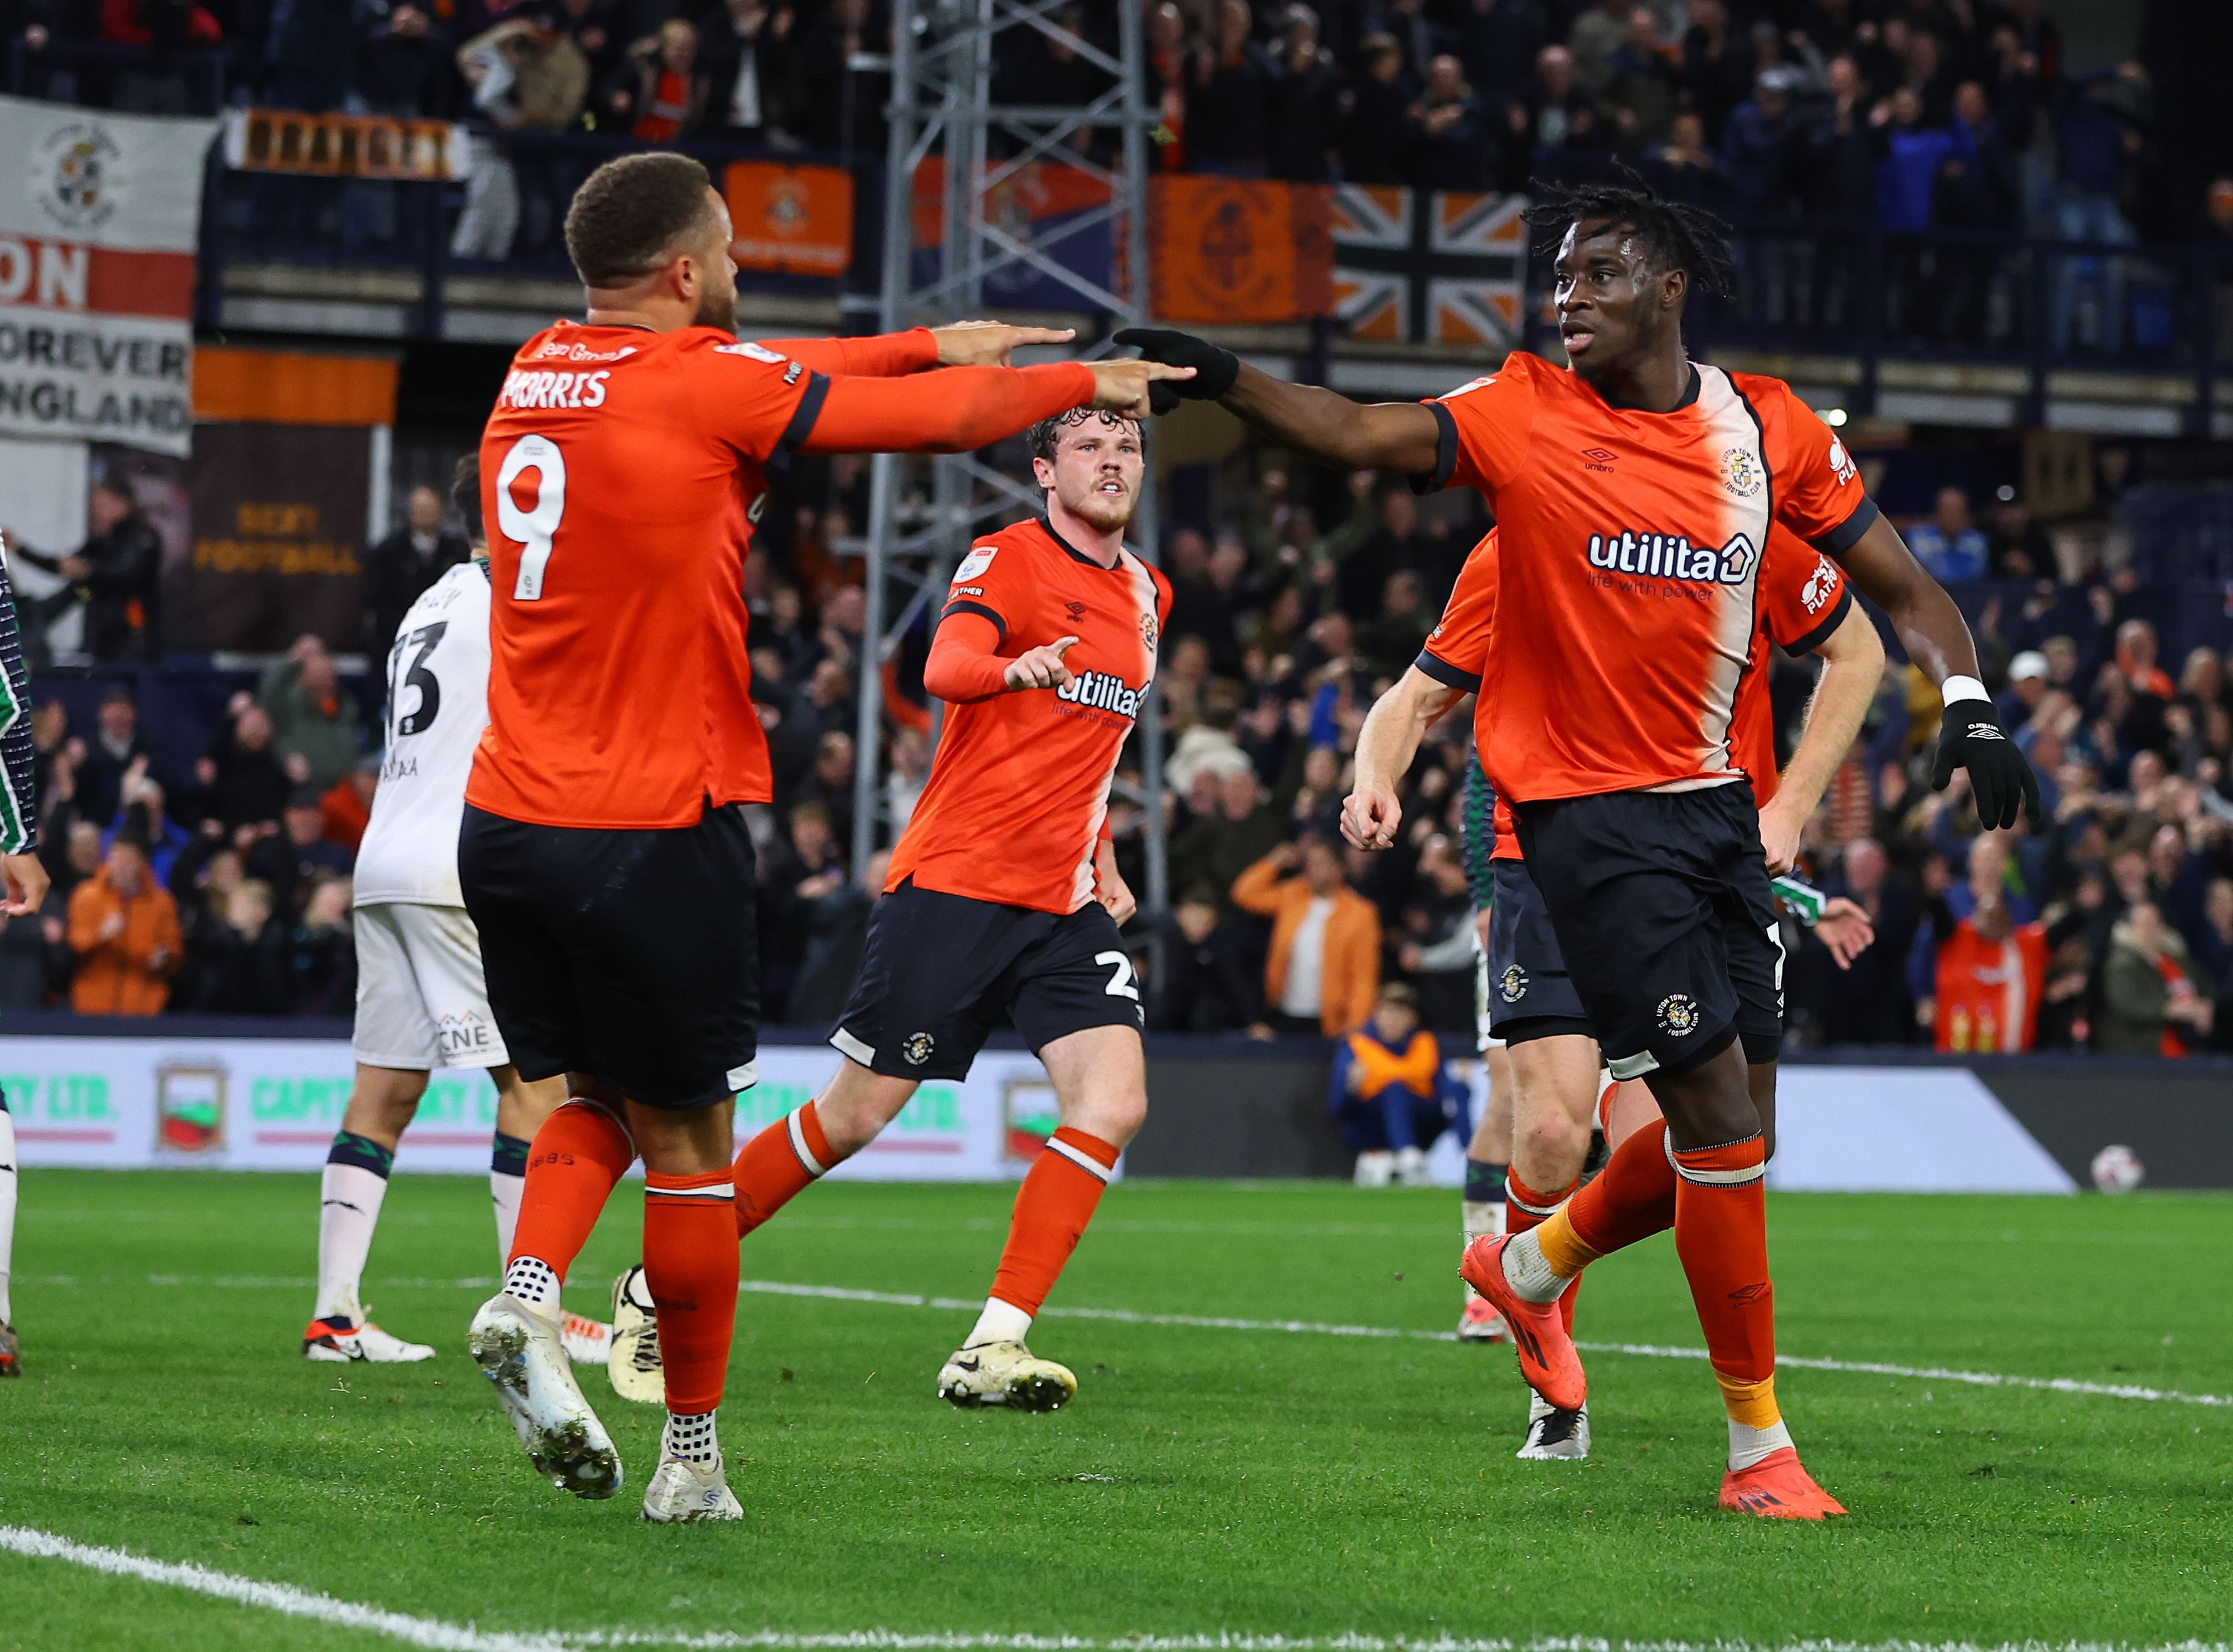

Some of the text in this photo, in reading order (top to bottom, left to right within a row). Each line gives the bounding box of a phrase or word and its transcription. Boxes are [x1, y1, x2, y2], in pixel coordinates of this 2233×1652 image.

[501, 370, 612, 408] MORRIS
[1585, 463, 1614, 473] umbro
[1722, 449, 1754, 462] LUTON TOWN
[1724, 481, 1761, 497] FOOTBALL CLUB
[495, 434, 567, 600] 9
[194, 539, 362, 575] FOOTBALL
[1589, 531, 1718, 581] utilita
[1588, 571, 1714, 601] life with power
[1057, 670, 1137, 716] utilita
[1968, 722, 1999, 732] umbro
[1094, 950, 1139, 1002] 2
[1656, 994, 1688, 1017] LUTON TOWN
[1667, 1012, 1699, 1037] FOOTBALL CLUB
